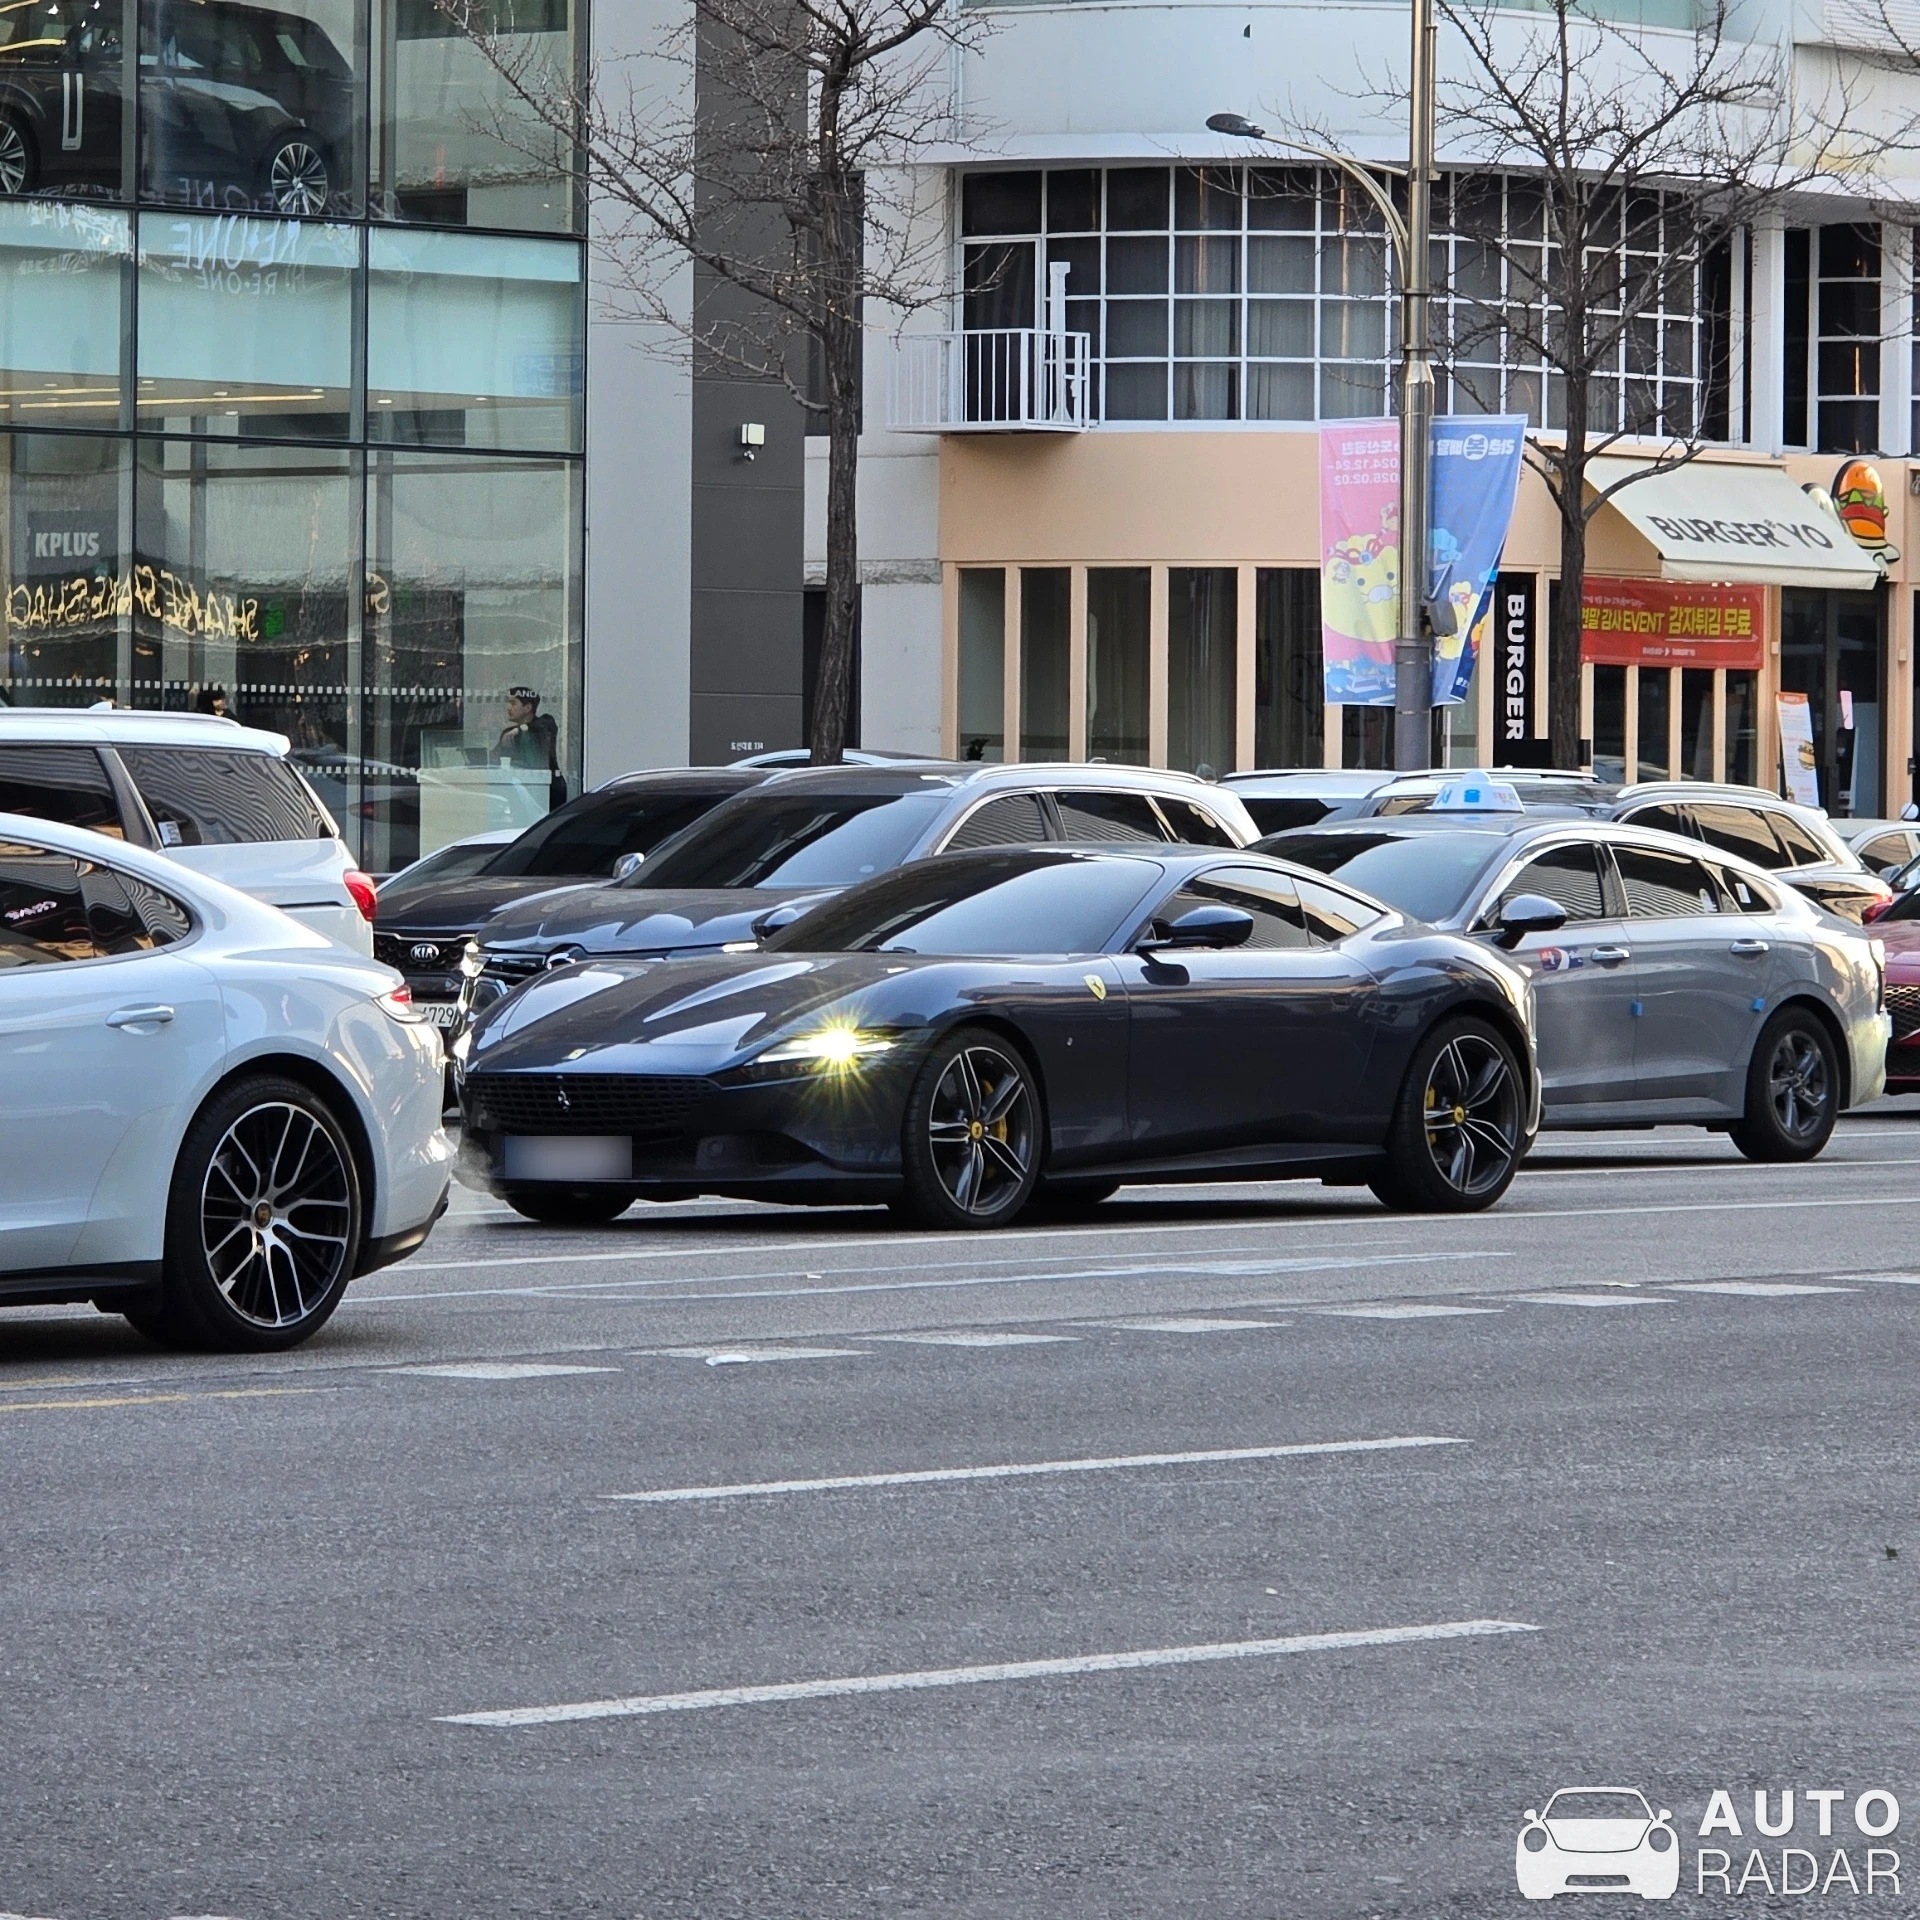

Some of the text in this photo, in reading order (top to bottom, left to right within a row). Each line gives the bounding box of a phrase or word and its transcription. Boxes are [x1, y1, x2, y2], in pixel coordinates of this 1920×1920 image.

[35, 532, 100, 557] KPLUS
[1646, 515, 1833, 549] BURGER YO
[1623, 610, 1665, 633] EVENT
[1668, 606, 1721, 635] 감자튀김
[1724, 608, 1751, 636] 무료
[1505, 594, 1525, 740] BURGER
[413, 946, 434, 959] KIA
